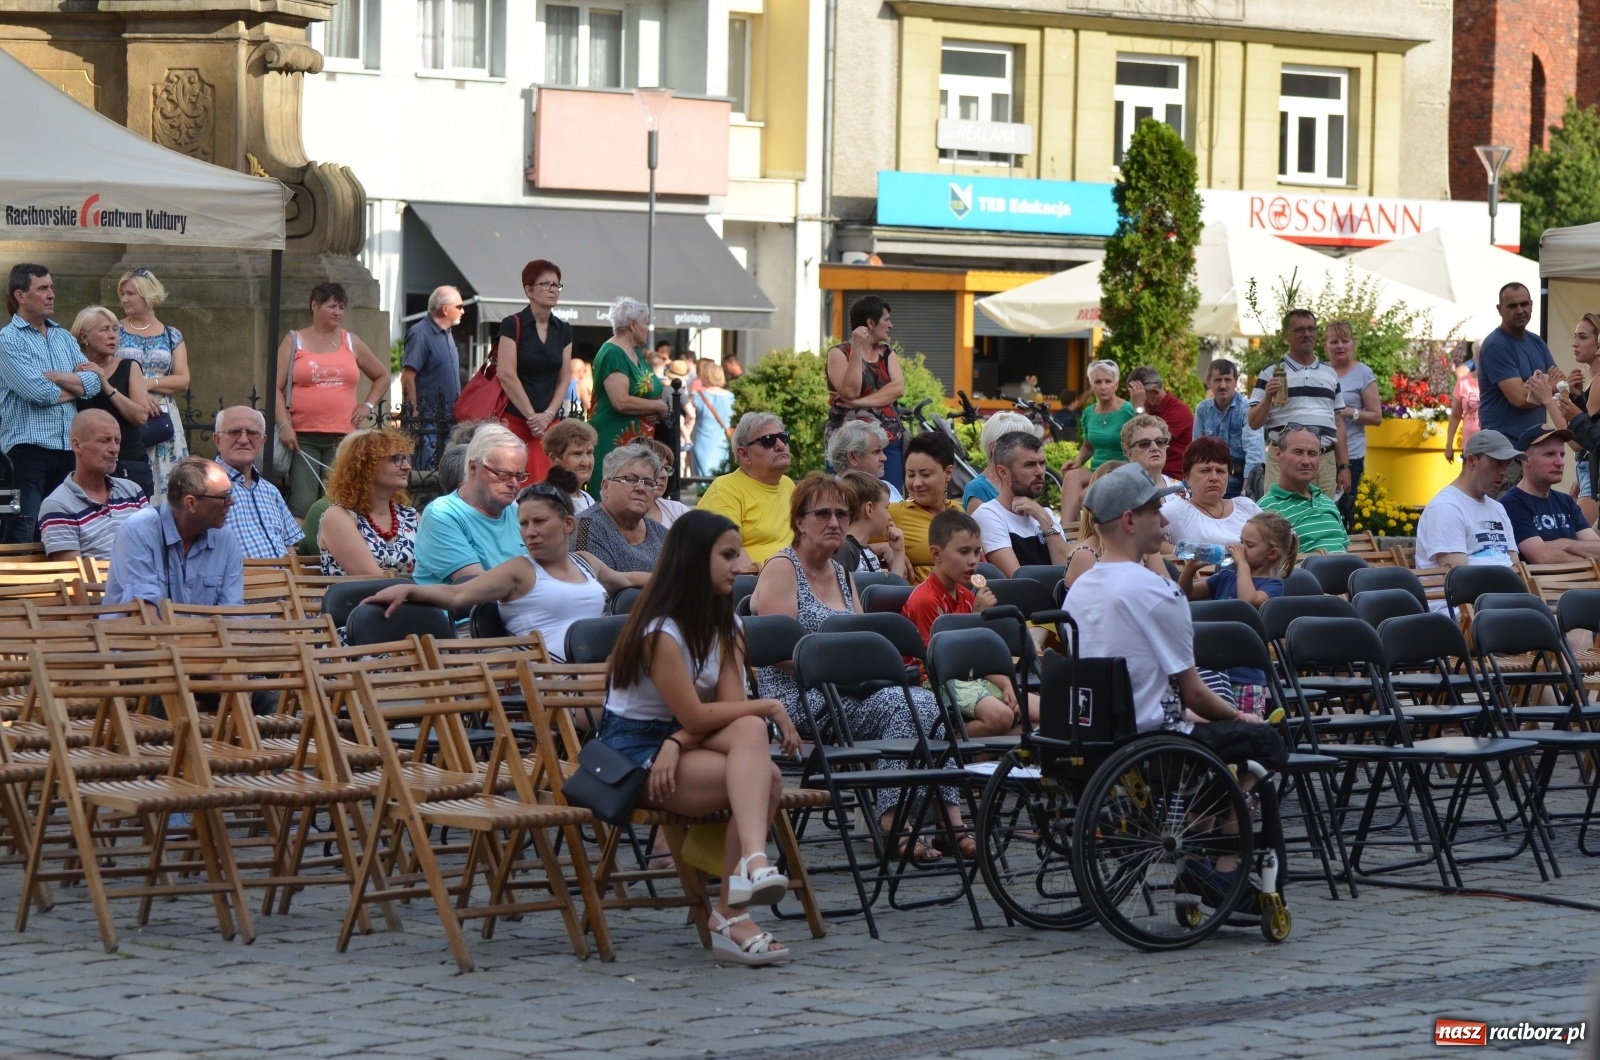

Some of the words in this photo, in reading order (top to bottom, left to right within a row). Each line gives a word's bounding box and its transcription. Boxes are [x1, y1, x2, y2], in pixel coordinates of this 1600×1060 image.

[5, 205, 77, 227] Raciborskie
[145, 209, 187, 235] Kultury
[977, 196, 1006, 213] TEB
[1009, 198, 1071, 218] Edukacja
[1249, 196, 1422, 235] ROSSMANN
